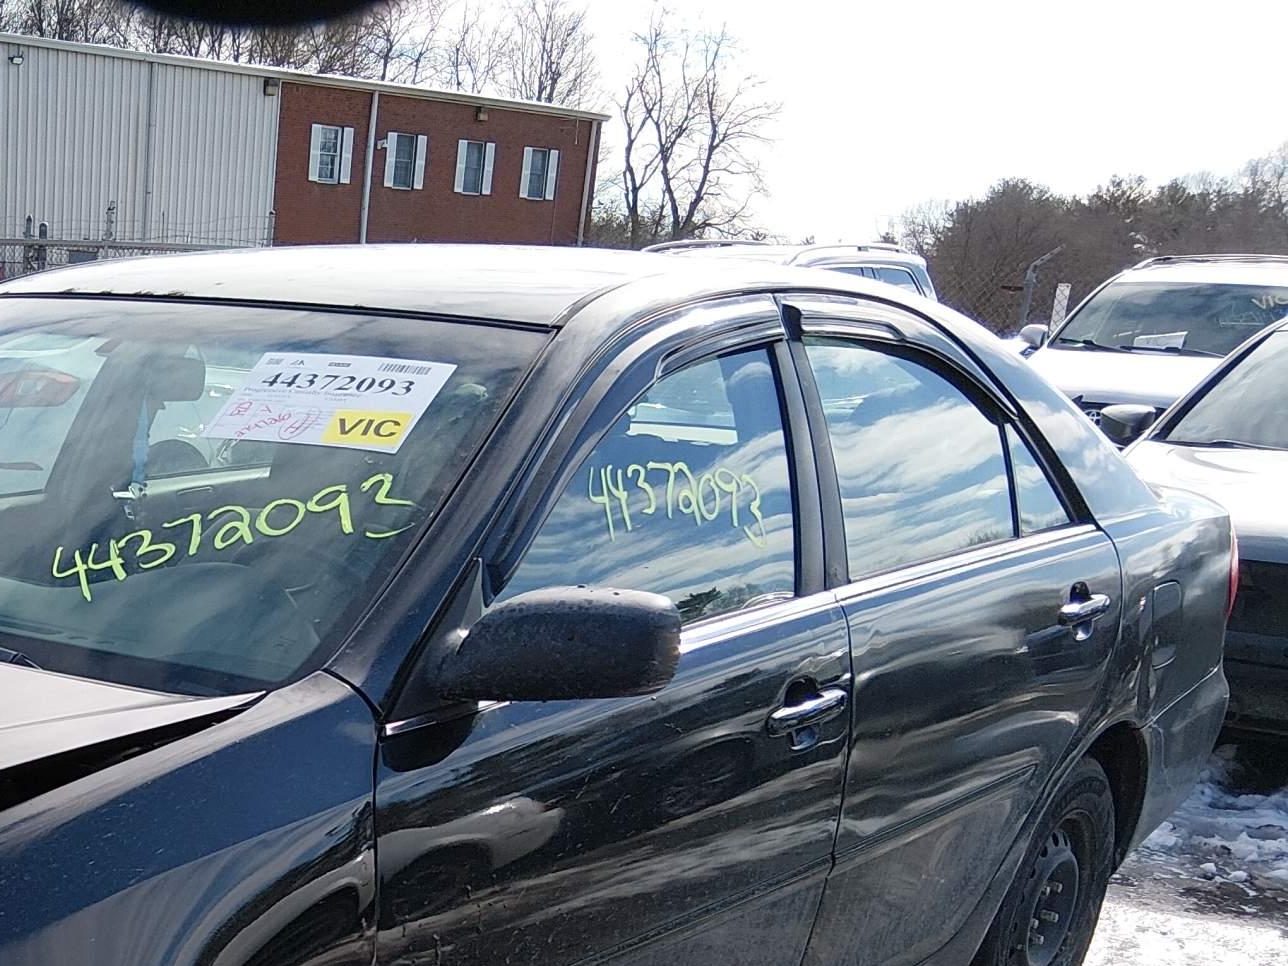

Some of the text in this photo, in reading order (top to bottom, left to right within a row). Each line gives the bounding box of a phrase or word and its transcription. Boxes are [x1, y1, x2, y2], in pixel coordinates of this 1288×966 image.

[261, 371, 416, 396] 44372093
[338, 417, 402, 438] VIC
[588, 461, 767, 548] 44372093
[52, 473, 416, 602] 44372093
